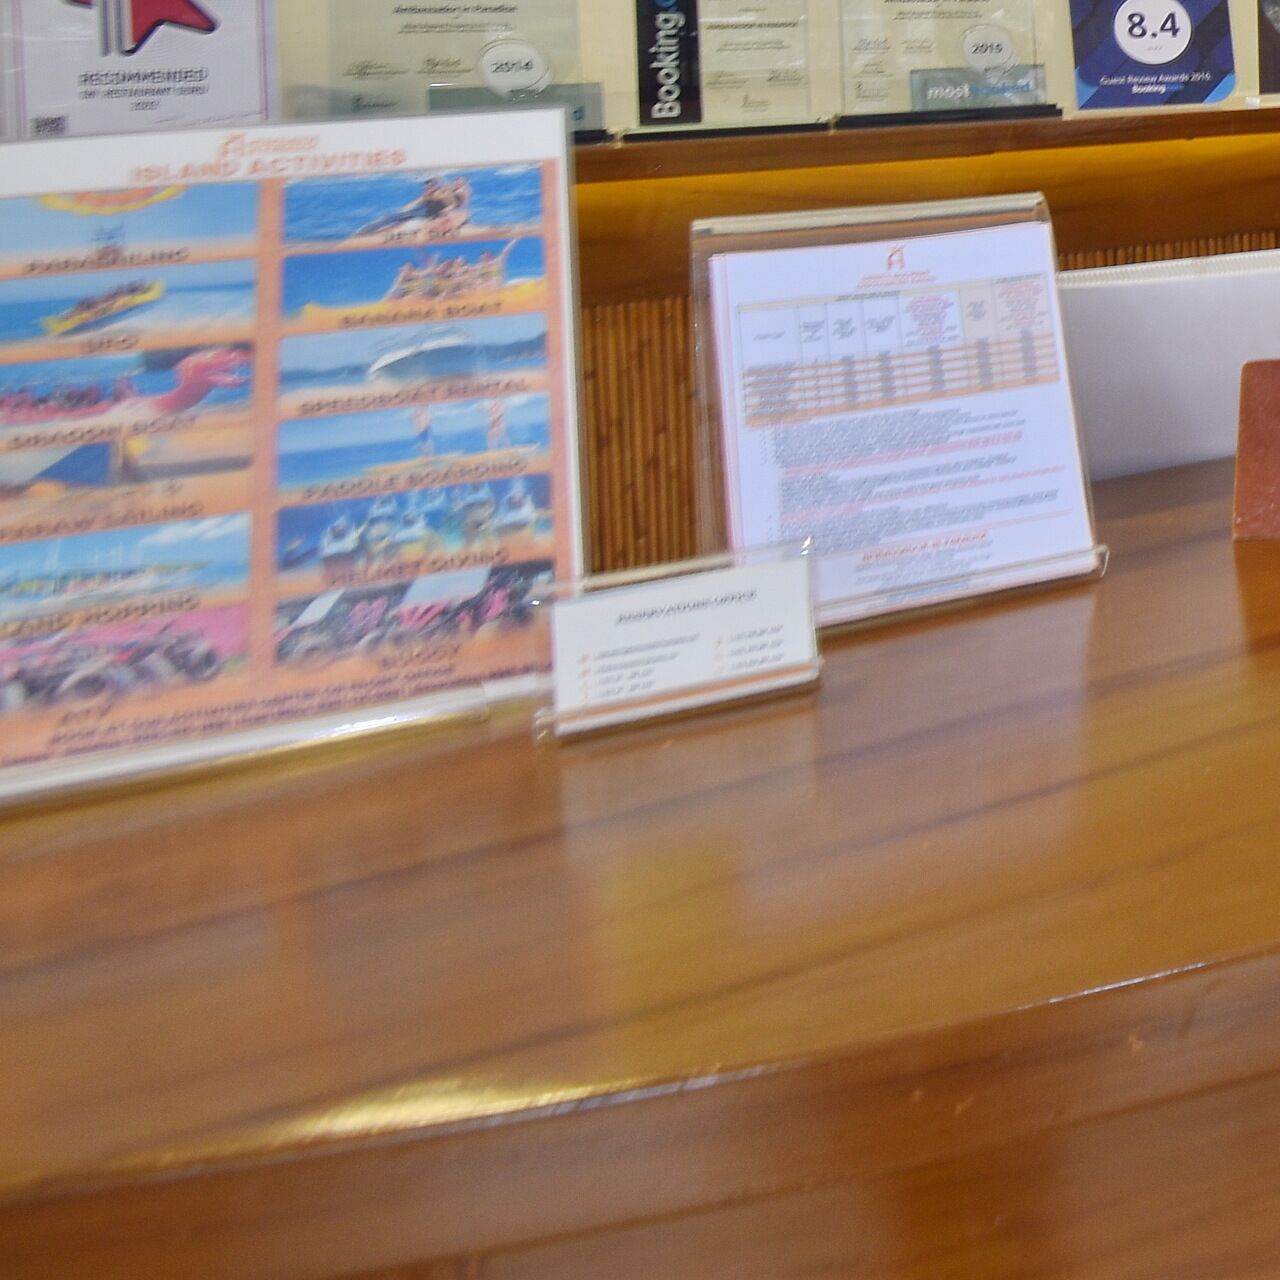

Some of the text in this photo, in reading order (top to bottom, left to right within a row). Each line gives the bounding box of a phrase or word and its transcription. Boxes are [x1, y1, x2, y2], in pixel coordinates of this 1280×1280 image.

[1127, 12, 1180, 39] 8.4
[133, 148, 408, 184] ISLAND ACTIVITIES
